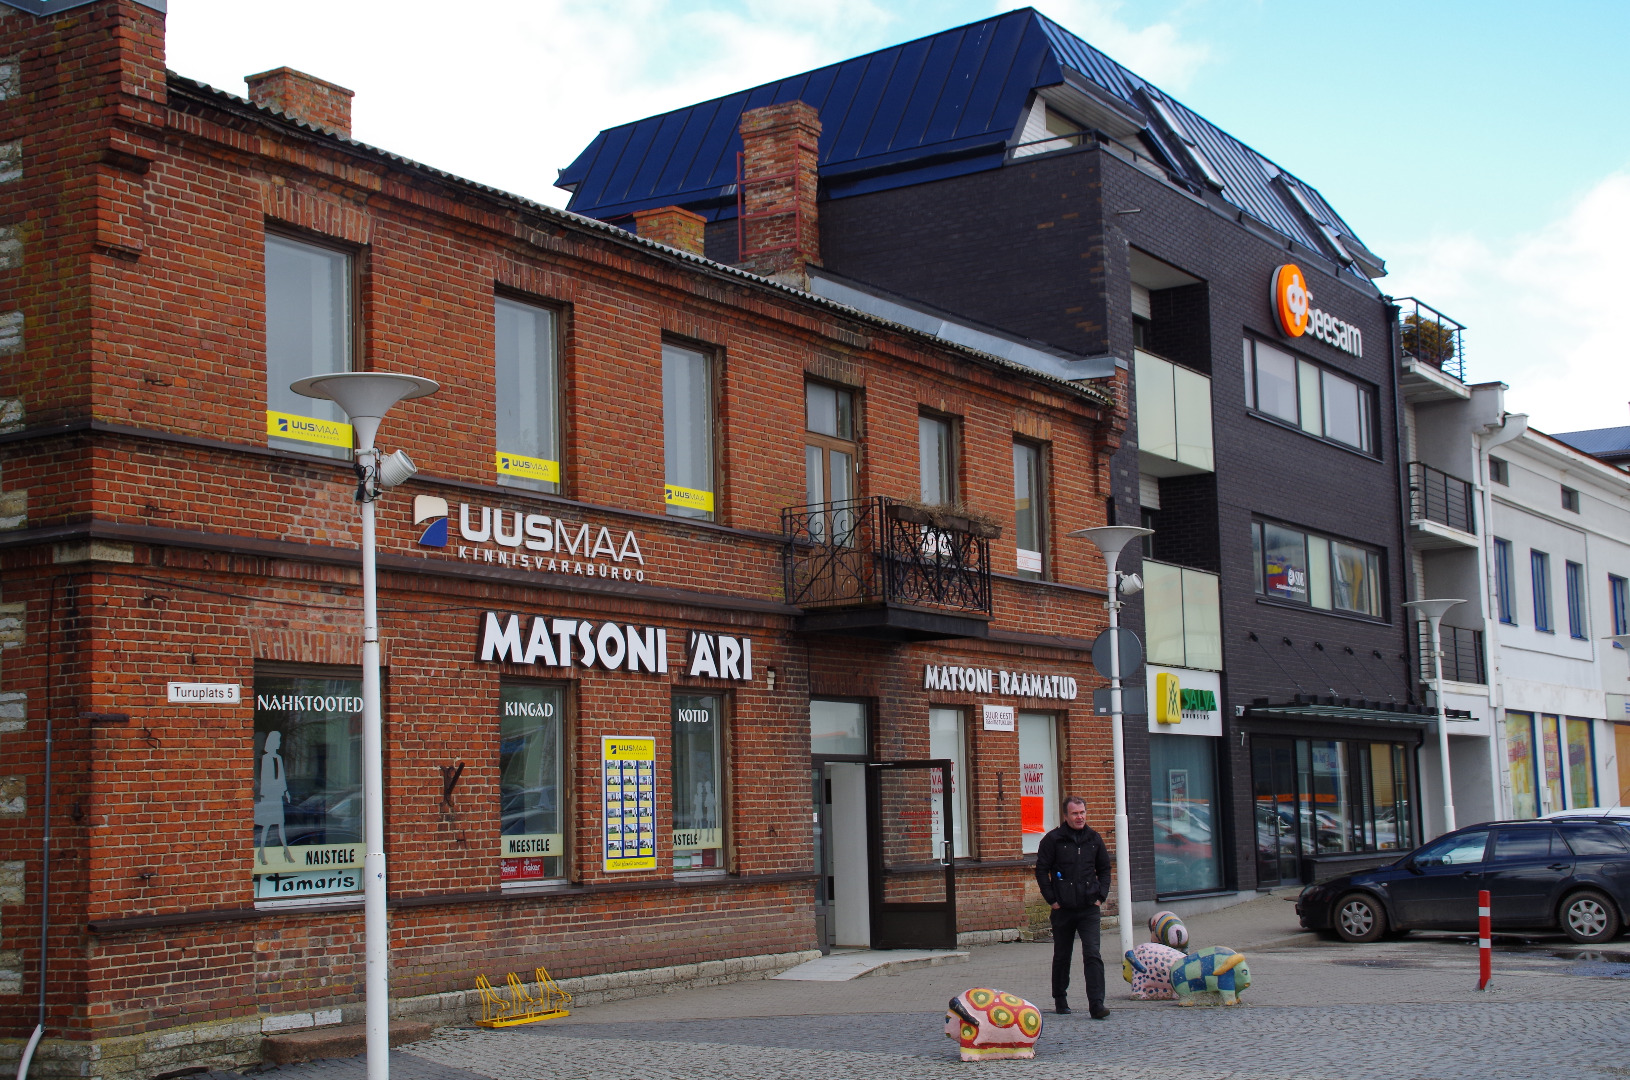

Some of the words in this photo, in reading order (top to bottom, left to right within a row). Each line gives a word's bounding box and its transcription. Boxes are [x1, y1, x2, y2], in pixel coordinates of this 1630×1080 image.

[291, 420, 339, 435] UUSMAA
[512, 459, 549, 472] UUSMAA
[674, 490, 705, 502] UUSMAA
[459, 502, 645, 566] UUSMAA
[457, 545, 645, 583] KINNISVARABÜROO
[480, 611, 668, 674] MATSONI
[690, 630, 752, 680] ÄRI
[924, 664, 993, 694] MATSONI
[999, 671, 1077, 700] RAAMATUD
[173, 686, 224, 700] Turuplats
[227, 688, 234, 698] 5
[1183, 688, 1217, 711] SALVA
[257, 694, 364, 712] NAHKTOOTED
[505, 701, 554, 718] KINGAD
[678, 708, 709, 723] KOTID
[1240, 731, 1245, 747] 7
[1024, 770, 1044, 783] VÄÄRT
[1024, 784, 1045, 796] VALIK
[509, 838, 551, 854] MEESTELE
[306, 848, 355, 866] NAISTELE
